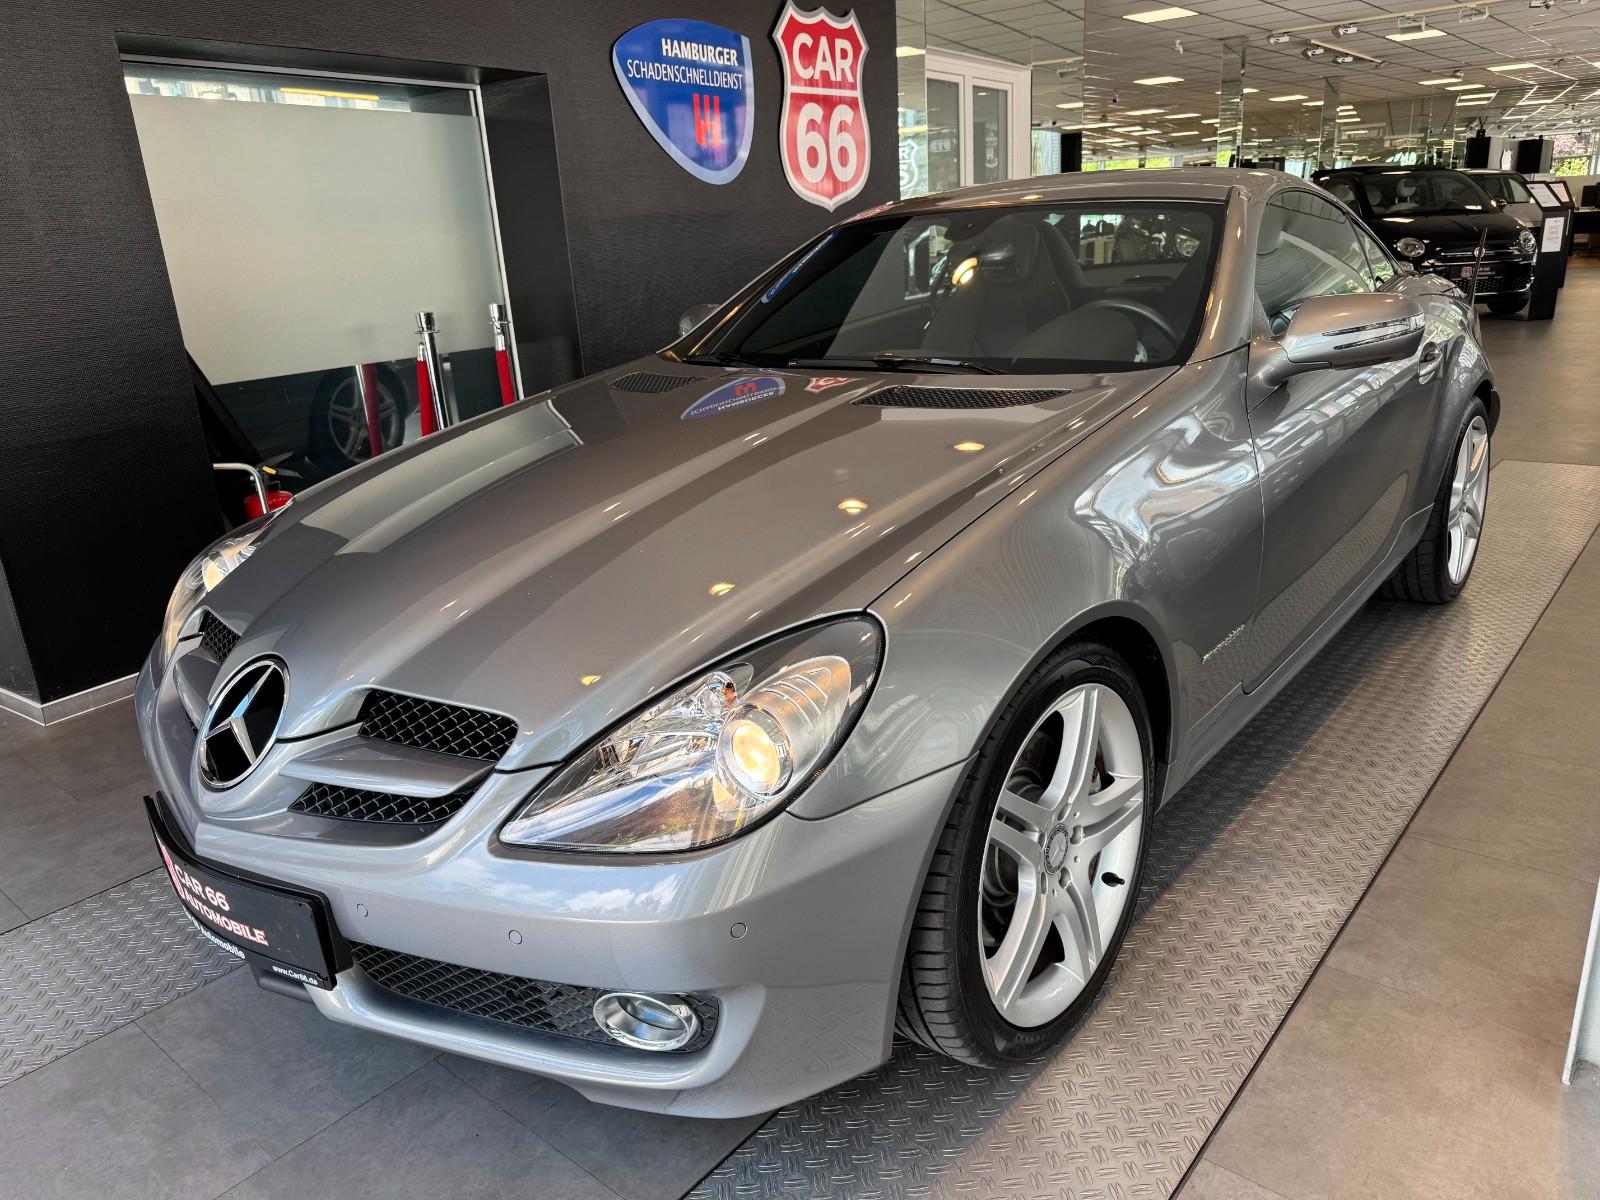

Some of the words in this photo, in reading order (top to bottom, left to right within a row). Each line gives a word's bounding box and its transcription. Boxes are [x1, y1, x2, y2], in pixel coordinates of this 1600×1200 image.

[627, 59, 744, 90] SCHADENSCHNELLDIENST
[661, 37, 739, 67] HAMBURGER
[792, 32, 855, 83] CAR
[796, 102, 858, 184] 66
[174, 863, 207, 900] CAR
[205, 886, 231, 911] 66
[184, 888, 270, 947] AUTOMOBILE
